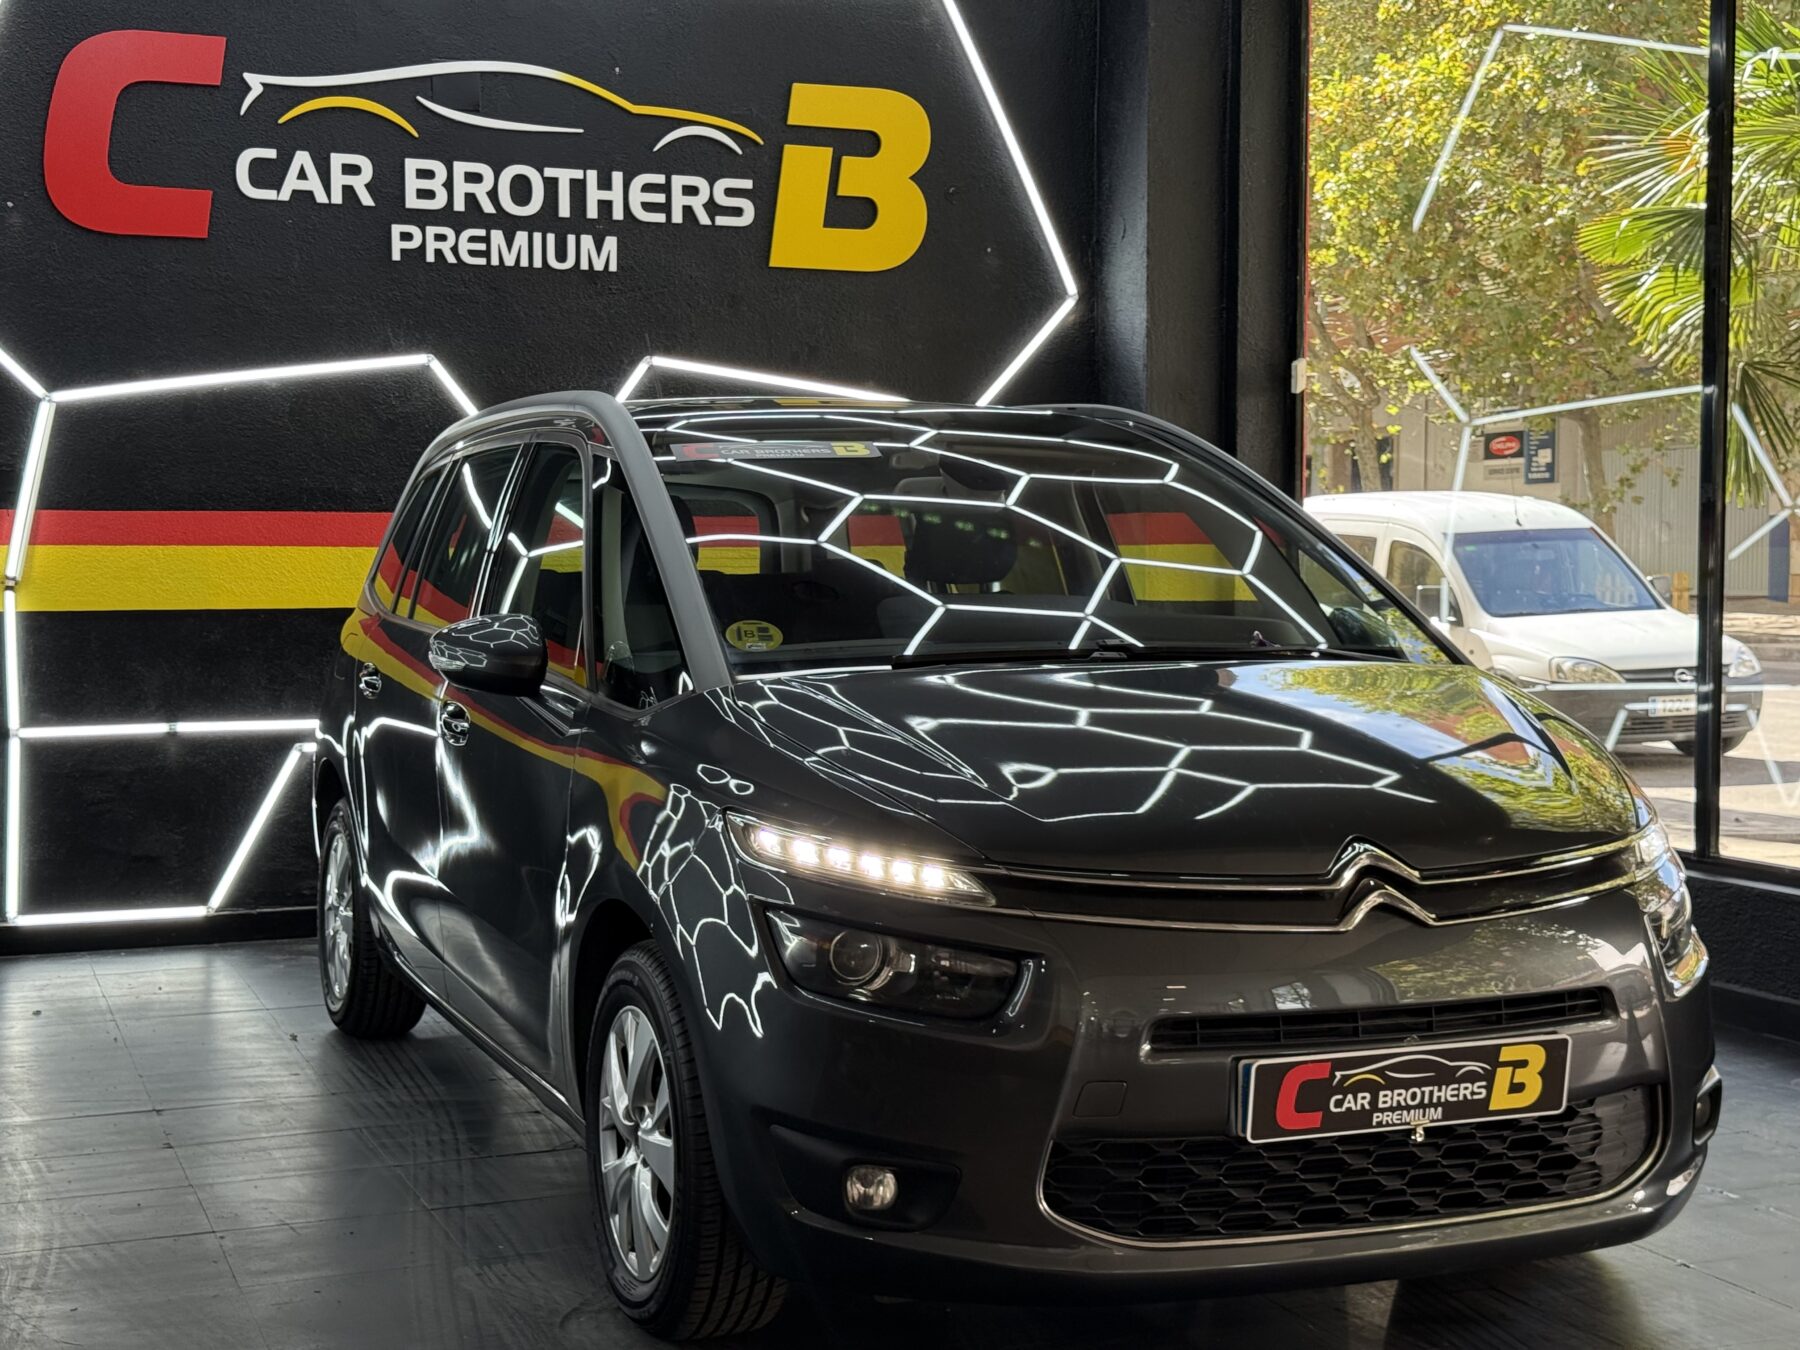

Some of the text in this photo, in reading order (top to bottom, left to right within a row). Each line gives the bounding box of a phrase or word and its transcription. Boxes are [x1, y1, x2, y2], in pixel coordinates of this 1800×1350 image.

[44, 29, 227, 238] C
[235, 147, 755, 227] CAR BROTHERS
[768, 82, 931, 272] B
[391, 223, 618, 272] PREMIUM
[1275, 1061, 1332, 1131] C
[1329, 1081, 1488, 1114] CAR BROTHERS
[1488, 1043, 1547, 1111] B
[1372, 1106, 1443, 1127] PREMIUM
